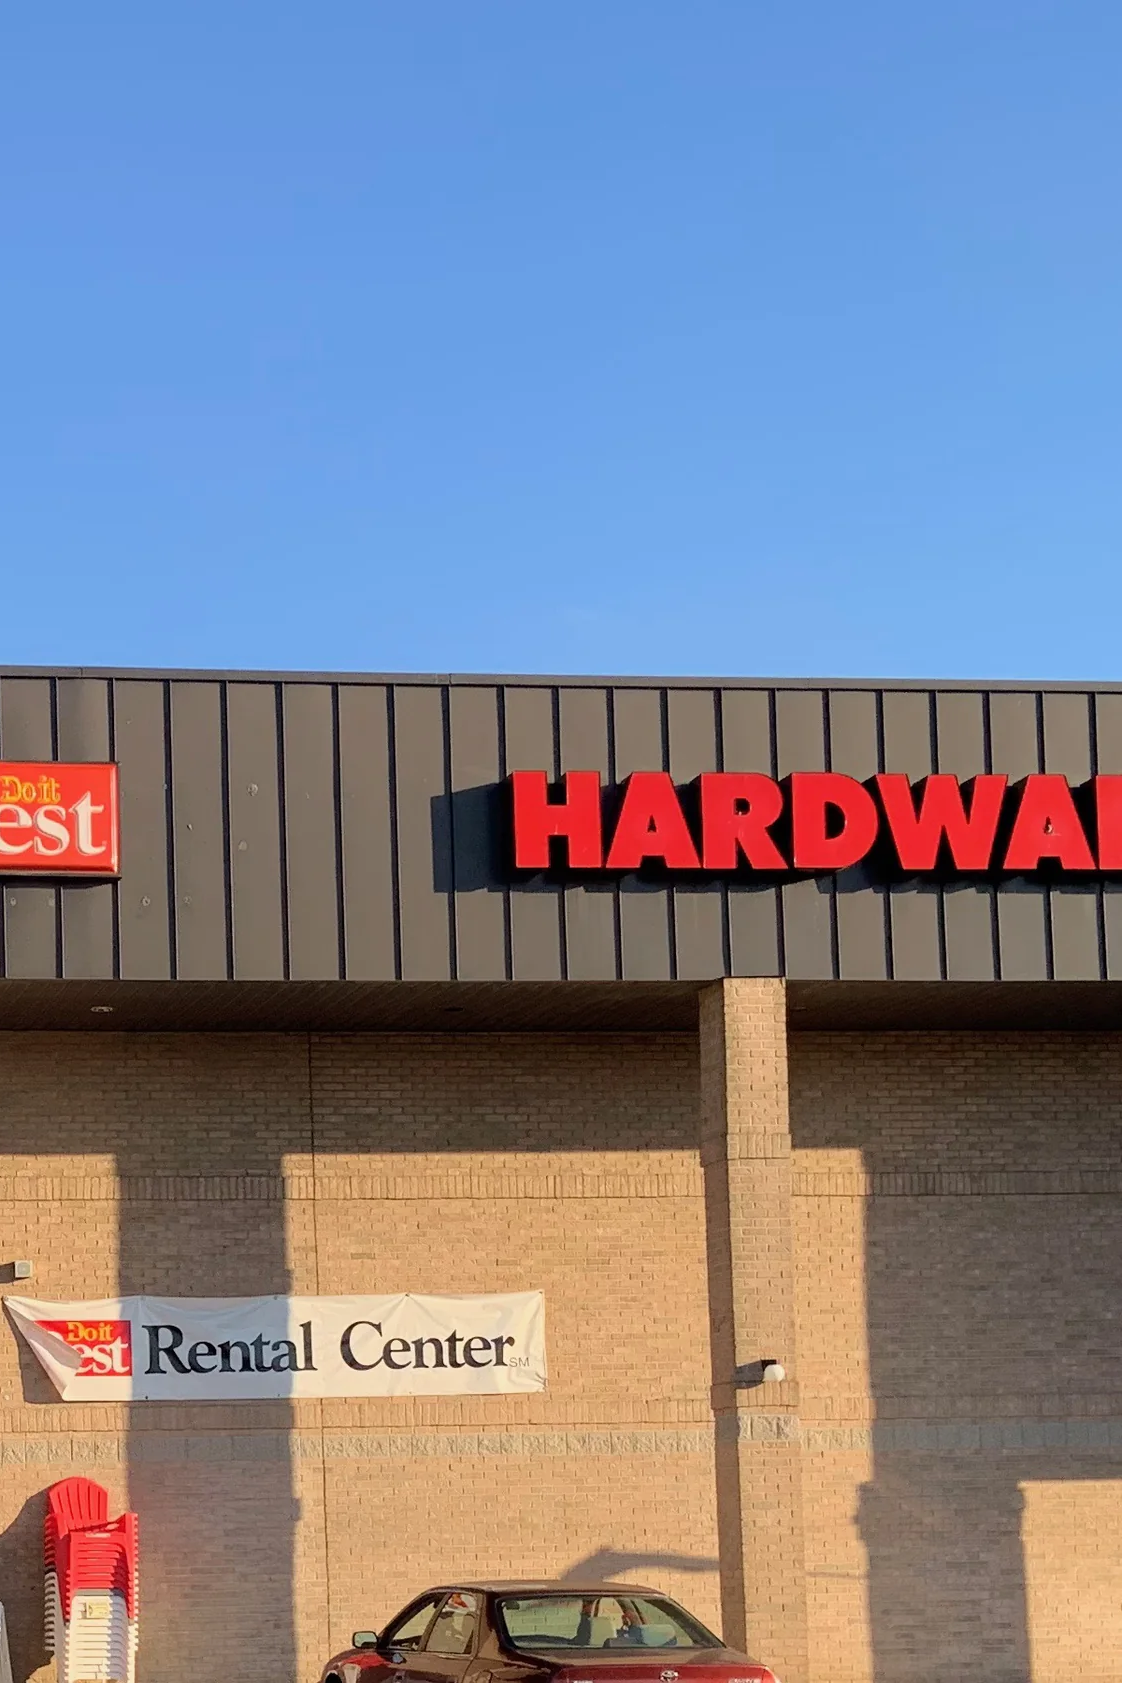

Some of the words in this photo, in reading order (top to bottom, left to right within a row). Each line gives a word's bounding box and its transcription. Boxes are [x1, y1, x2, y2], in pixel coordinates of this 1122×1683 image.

[0, 775, 36, 804] Do
[38, 774, 61, 804] it
[512, 770, 1122, 871] HARDWA
[66, 1321, 97, 1341] Do
[98, 1322, 114, 1341] it
[142, 1321, 318, 1374] Rental
[340, 1320, 515, 1371] Center
[509, 1357, 530, 1367] SM
[53, 1333, 130, 1374] est
